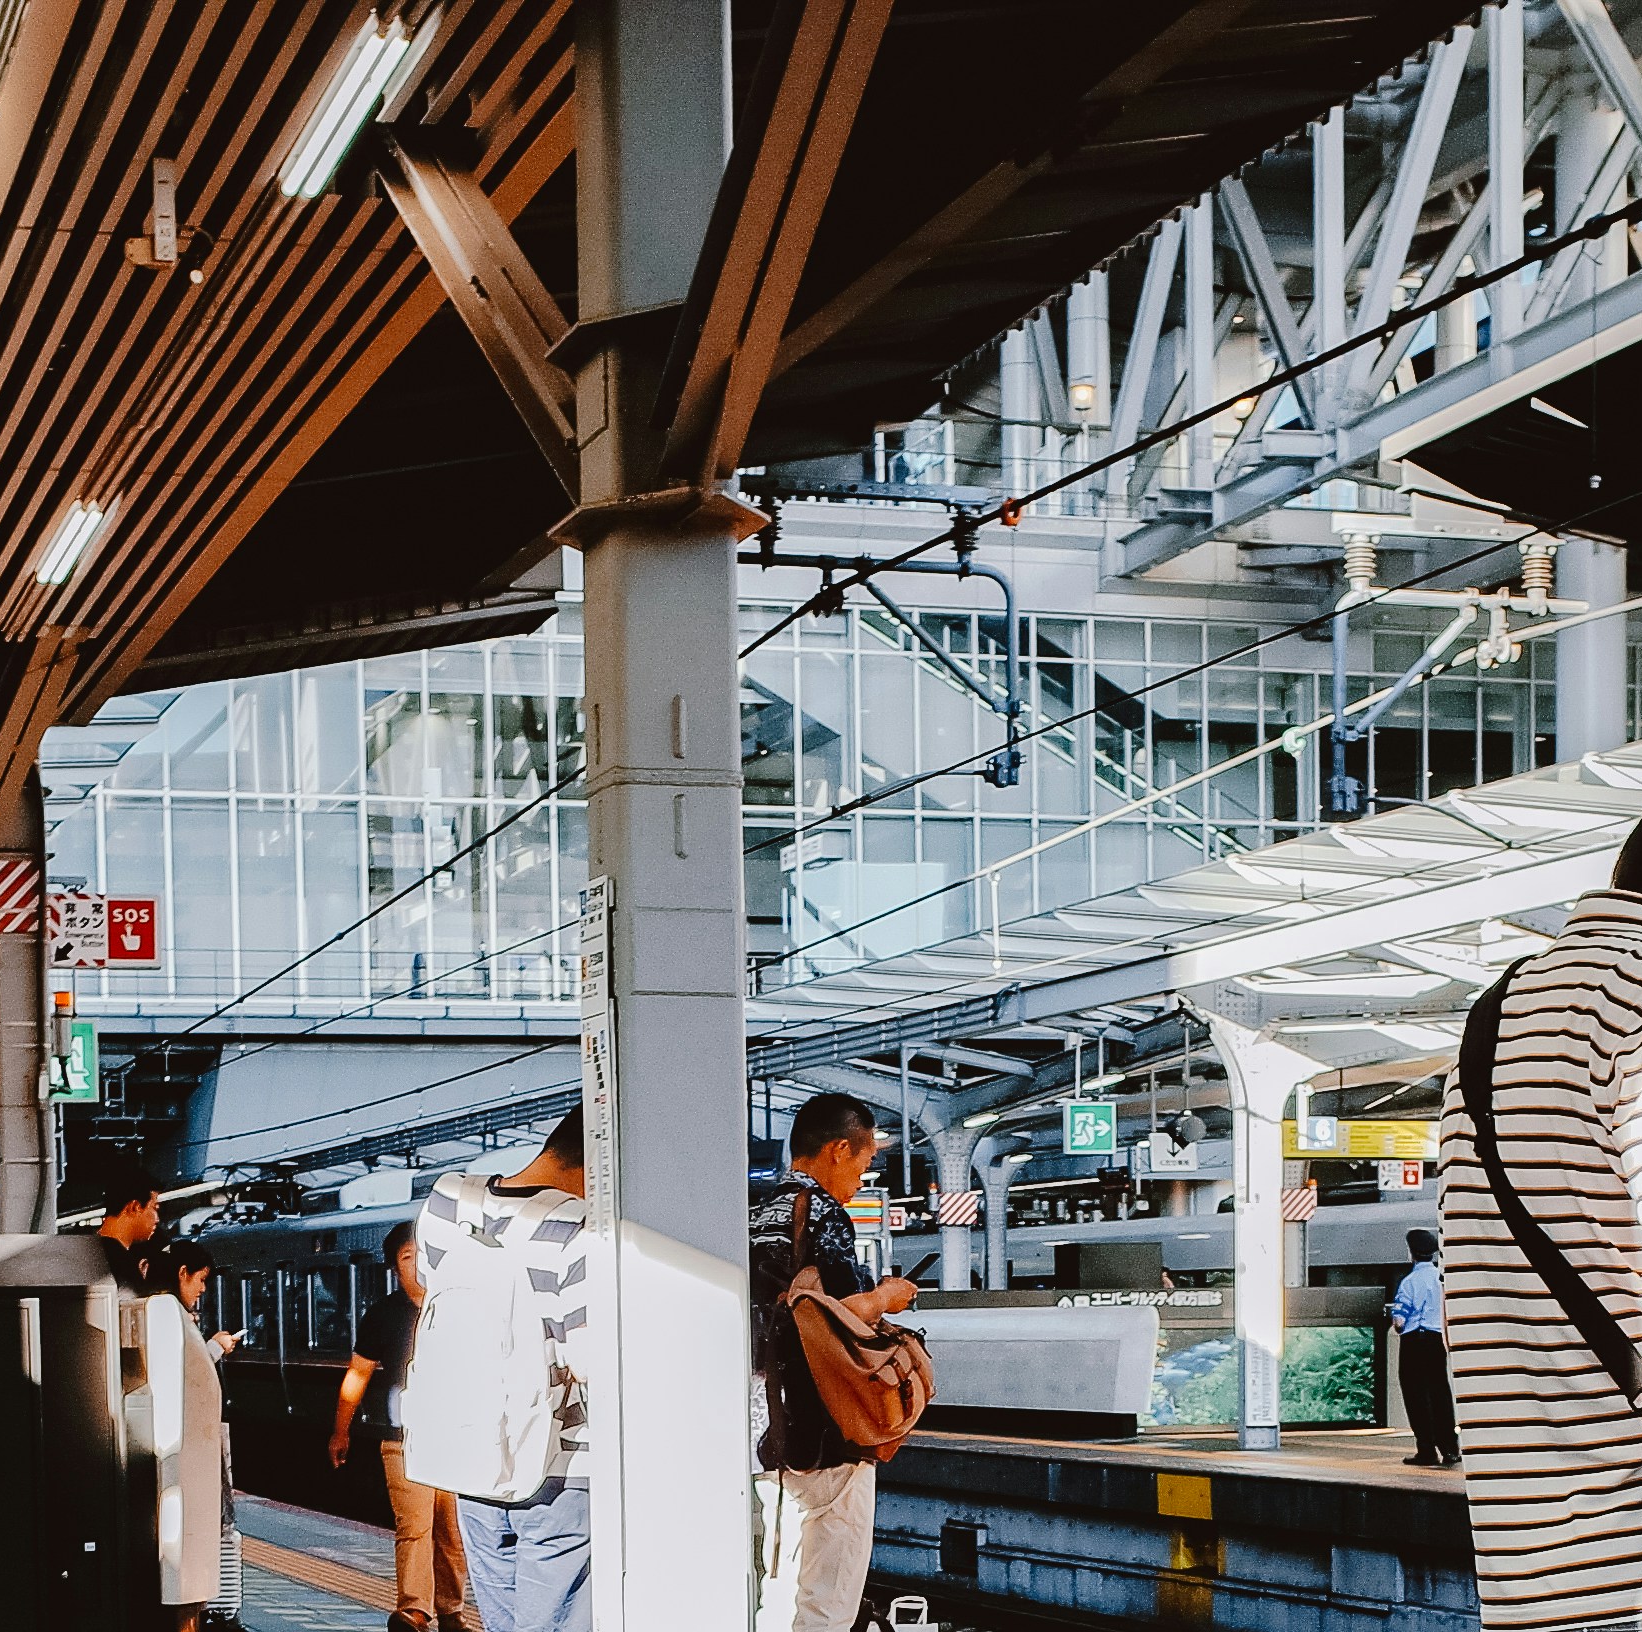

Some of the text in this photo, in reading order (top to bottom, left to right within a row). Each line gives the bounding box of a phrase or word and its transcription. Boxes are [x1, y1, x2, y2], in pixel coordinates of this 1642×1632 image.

[65, 917, 105, 929] ボタン
[112, 908, 150, 923] SOS
[1315, 1118, 1332, 1141] 6
